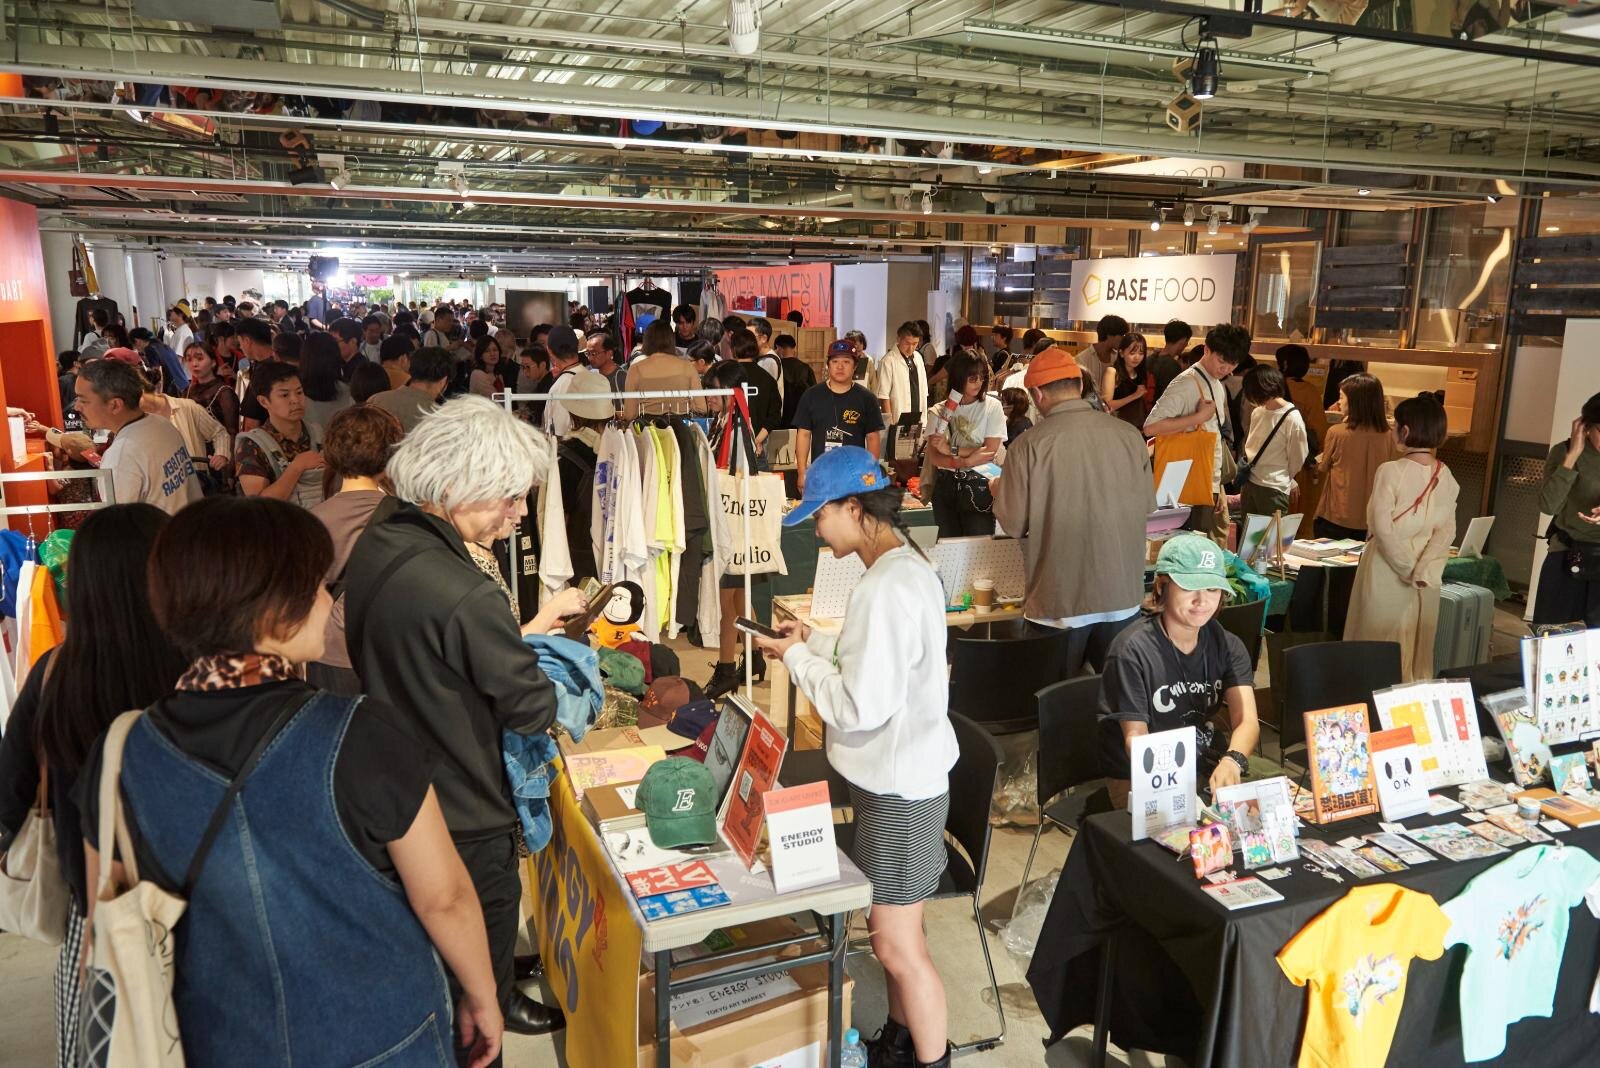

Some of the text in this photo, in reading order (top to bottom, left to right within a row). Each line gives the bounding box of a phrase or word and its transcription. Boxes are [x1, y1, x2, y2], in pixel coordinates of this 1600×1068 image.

[1106, 277, 1216, 302] BASE FOOD
[613, 630, 625, 640] E
[672, 788, 696, 812] E
[780, 828, 823, 843] ENERGY
[783, 836, 824, 850] STUDIO
[708, 980, 749, 1001] ENERGY
[705, 992, 767, 1017] TOKYO ART MARKET
